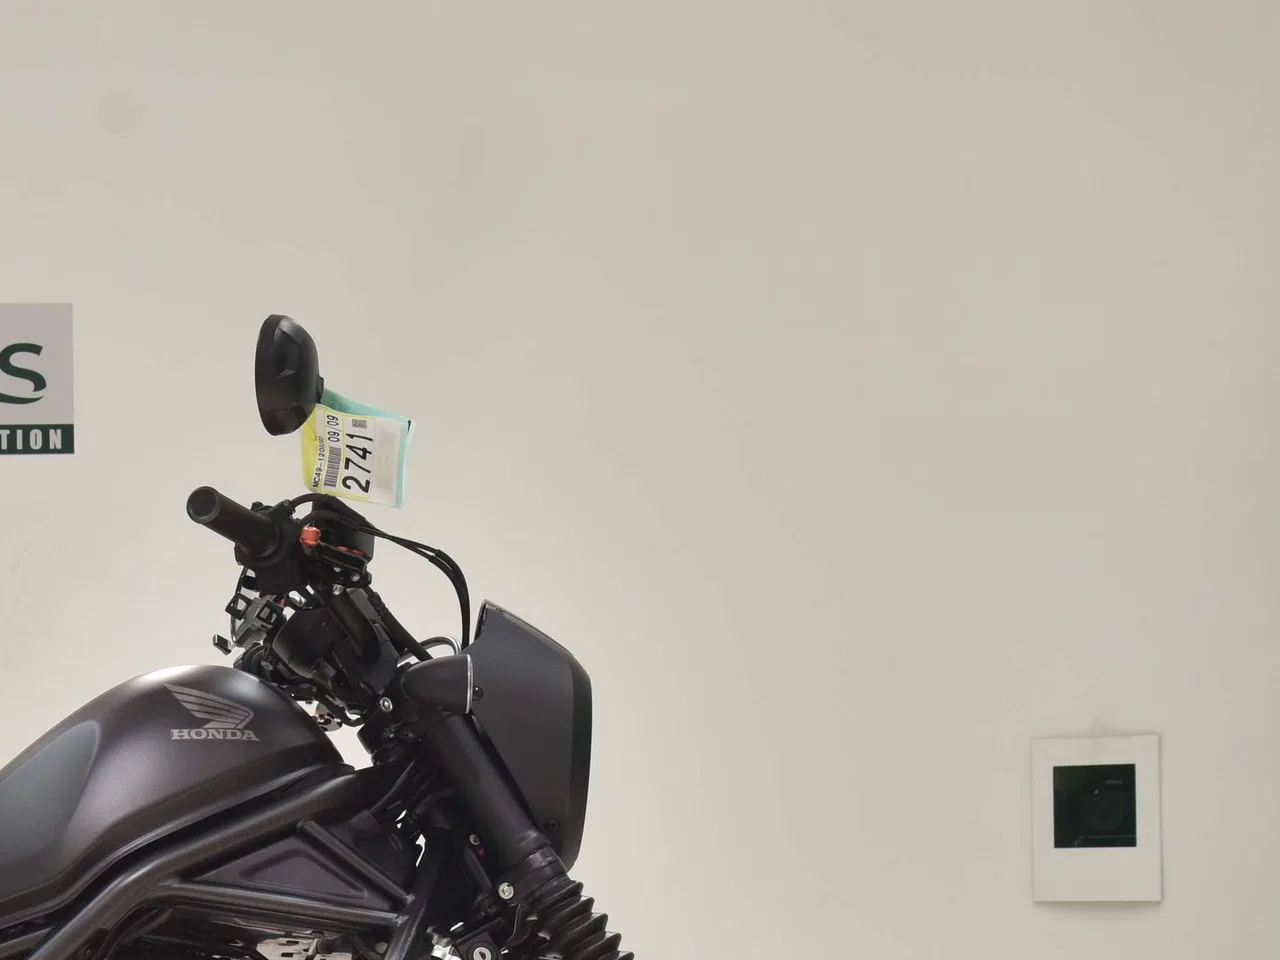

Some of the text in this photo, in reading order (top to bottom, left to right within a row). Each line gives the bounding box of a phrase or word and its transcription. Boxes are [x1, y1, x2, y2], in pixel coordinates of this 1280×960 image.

[326, 414, 342, 443] 09/09
[341, 433, 373, 494] 2741
[170, 728, 261, 742] HONDA
